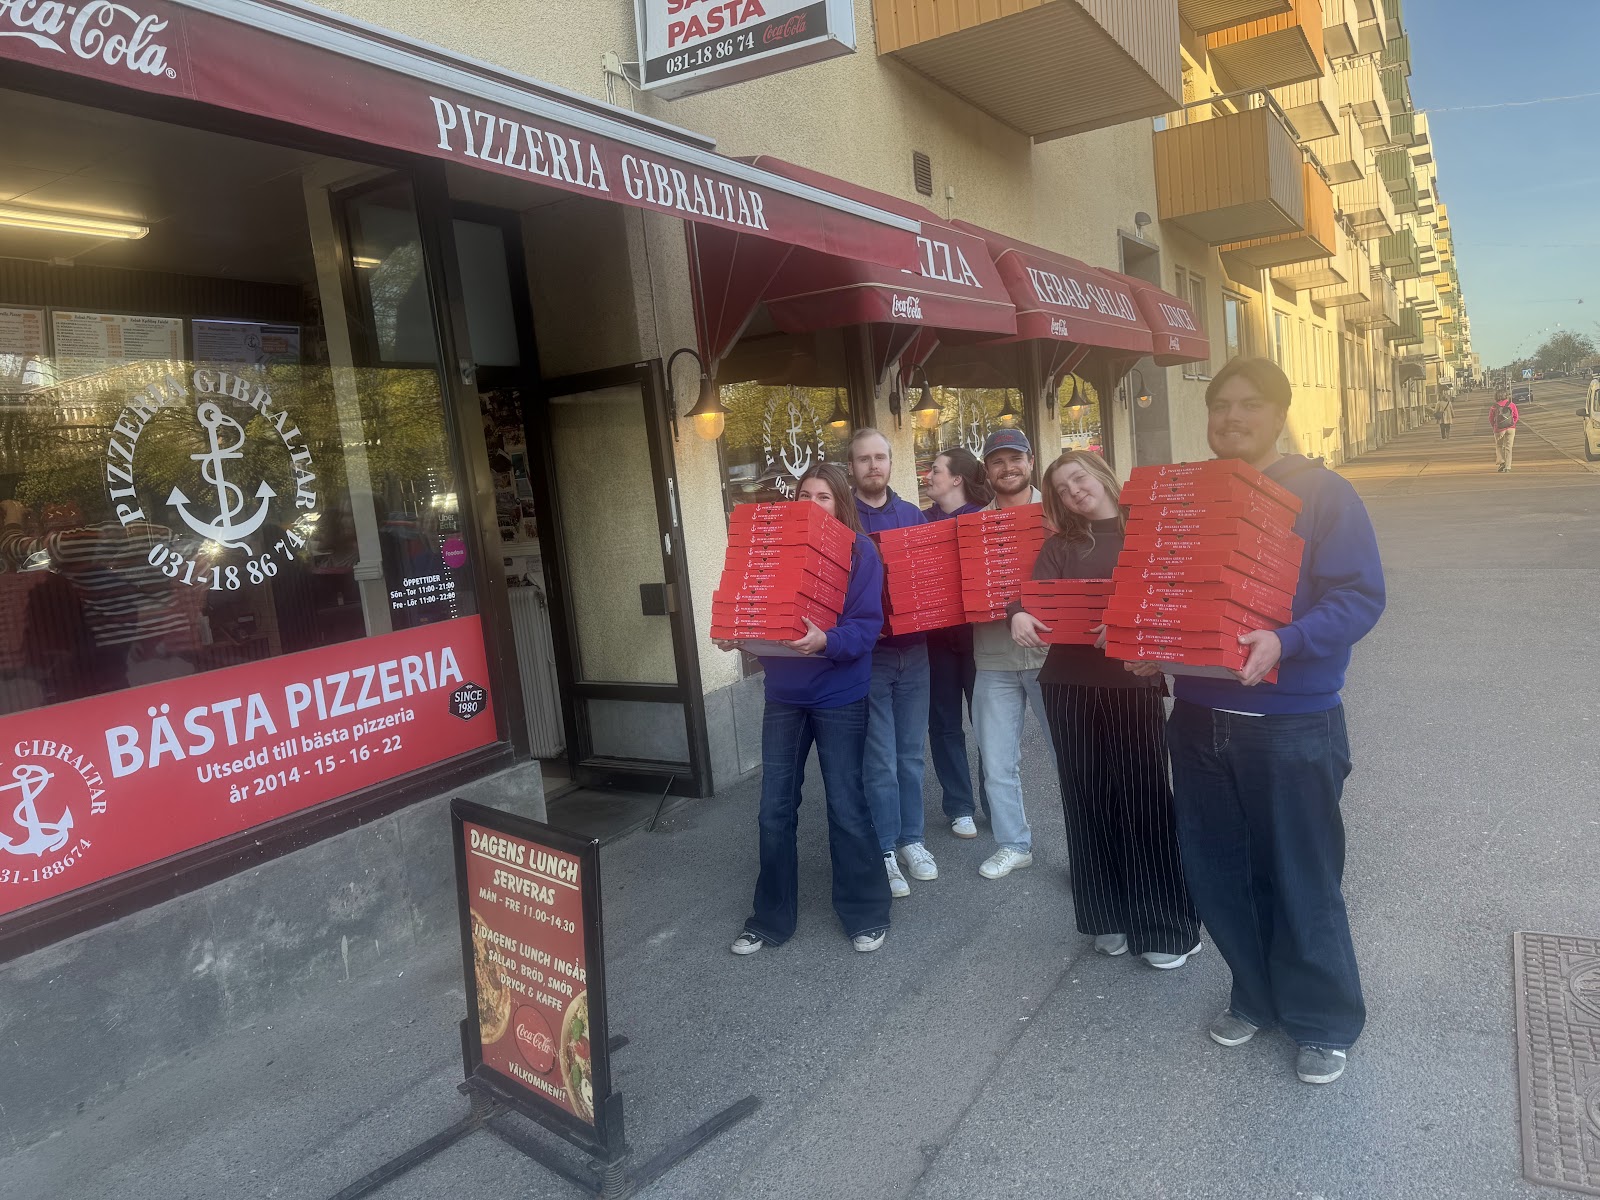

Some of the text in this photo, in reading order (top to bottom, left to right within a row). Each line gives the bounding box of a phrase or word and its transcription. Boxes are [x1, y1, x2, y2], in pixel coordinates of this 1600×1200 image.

[666, 12, 808, 74] 031-18 86 74 Coca-Cola
[668, 0, 766, 48] PASTA
[430, 96, 769, 231] PIZZERIA GIBRALTAR
[917, 236, 984, 289] ZZA
[1158, 302, 1197, 332] LUNCH
[107, 373, 190, 526] PIZZERIA
[193, 369, 317, 510] GIBRALTAR
[148, 528, 307, 591] 031-18 86 74
[403, 574, 441, 587] ÖPPETTIDER
[390, 590, 403, 599] Sön
[406, 588, 416, 596] Tor
[392, 602, 403, 610] Fre
[407, 598, 417, 607] Lör
[105, 646, 463, 779] BÄSTA PIZZERIA
[454, 690, 483, 703] SINCE
[458, 702, 478, 714] 1980
[196, 707, 415, 784] Utsedd till bästa pizzeria
[229, 785, 249, 804] år
[254, 766, 300, 797] 2014
[315, 755, 336, 776] 15
[350, 745, 370, 764] 16
[382, 735, 402, 754] 22
[14, 739, 108, 816] GIBRALTAR
[470, 828, 579, 883] DAGENS LUNCH
[479, 886, 497, 904] MÅN
[505, 897, 521, 913] FRE
[493, 869, 556, 906] SERVERAS
[481, 926, 517, 953] DAGENS
[520, 943, 551, 967] LUNCH
[554, 957, 587, 984] INGÅR
[488, 949, 573, 998] SALLAD, BRÖD, SMÖR
[500, 973, 563, 1012] DRYCK & KAFFE
[516, 1023, 552, 1054] Coca-Cola
